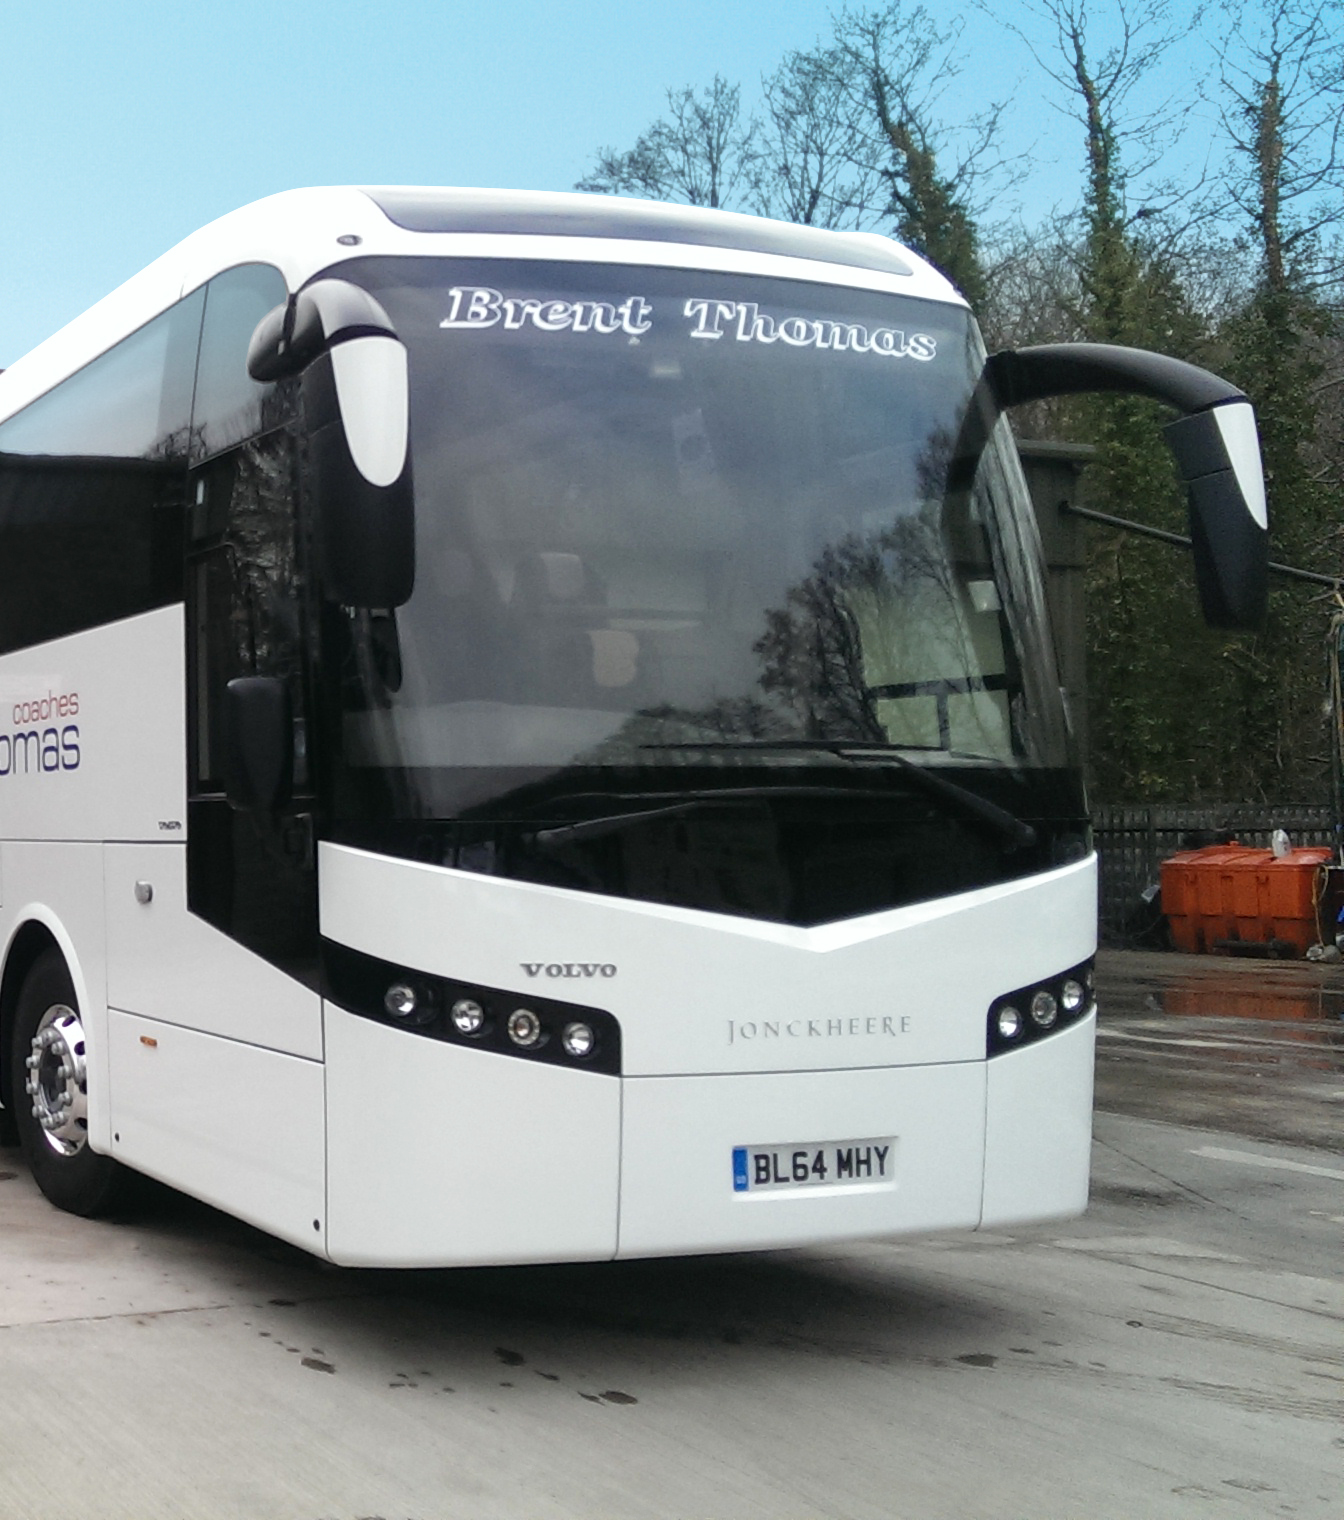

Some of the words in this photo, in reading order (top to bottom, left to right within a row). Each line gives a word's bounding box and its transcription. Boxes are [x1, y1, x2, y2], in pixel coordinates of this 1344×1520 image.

[439, 286, 653, 335] Brent
[683, 297, 938, 361] Thomas
[12, 690, 79, 725] coaches
[519, 963, 617, 978] VOLVO
[727, 1016, 911, 1045] JONCKHEERE
[753, 1150, 827, 1185] BL64
[837, 1146, 889, 1179] MHY
